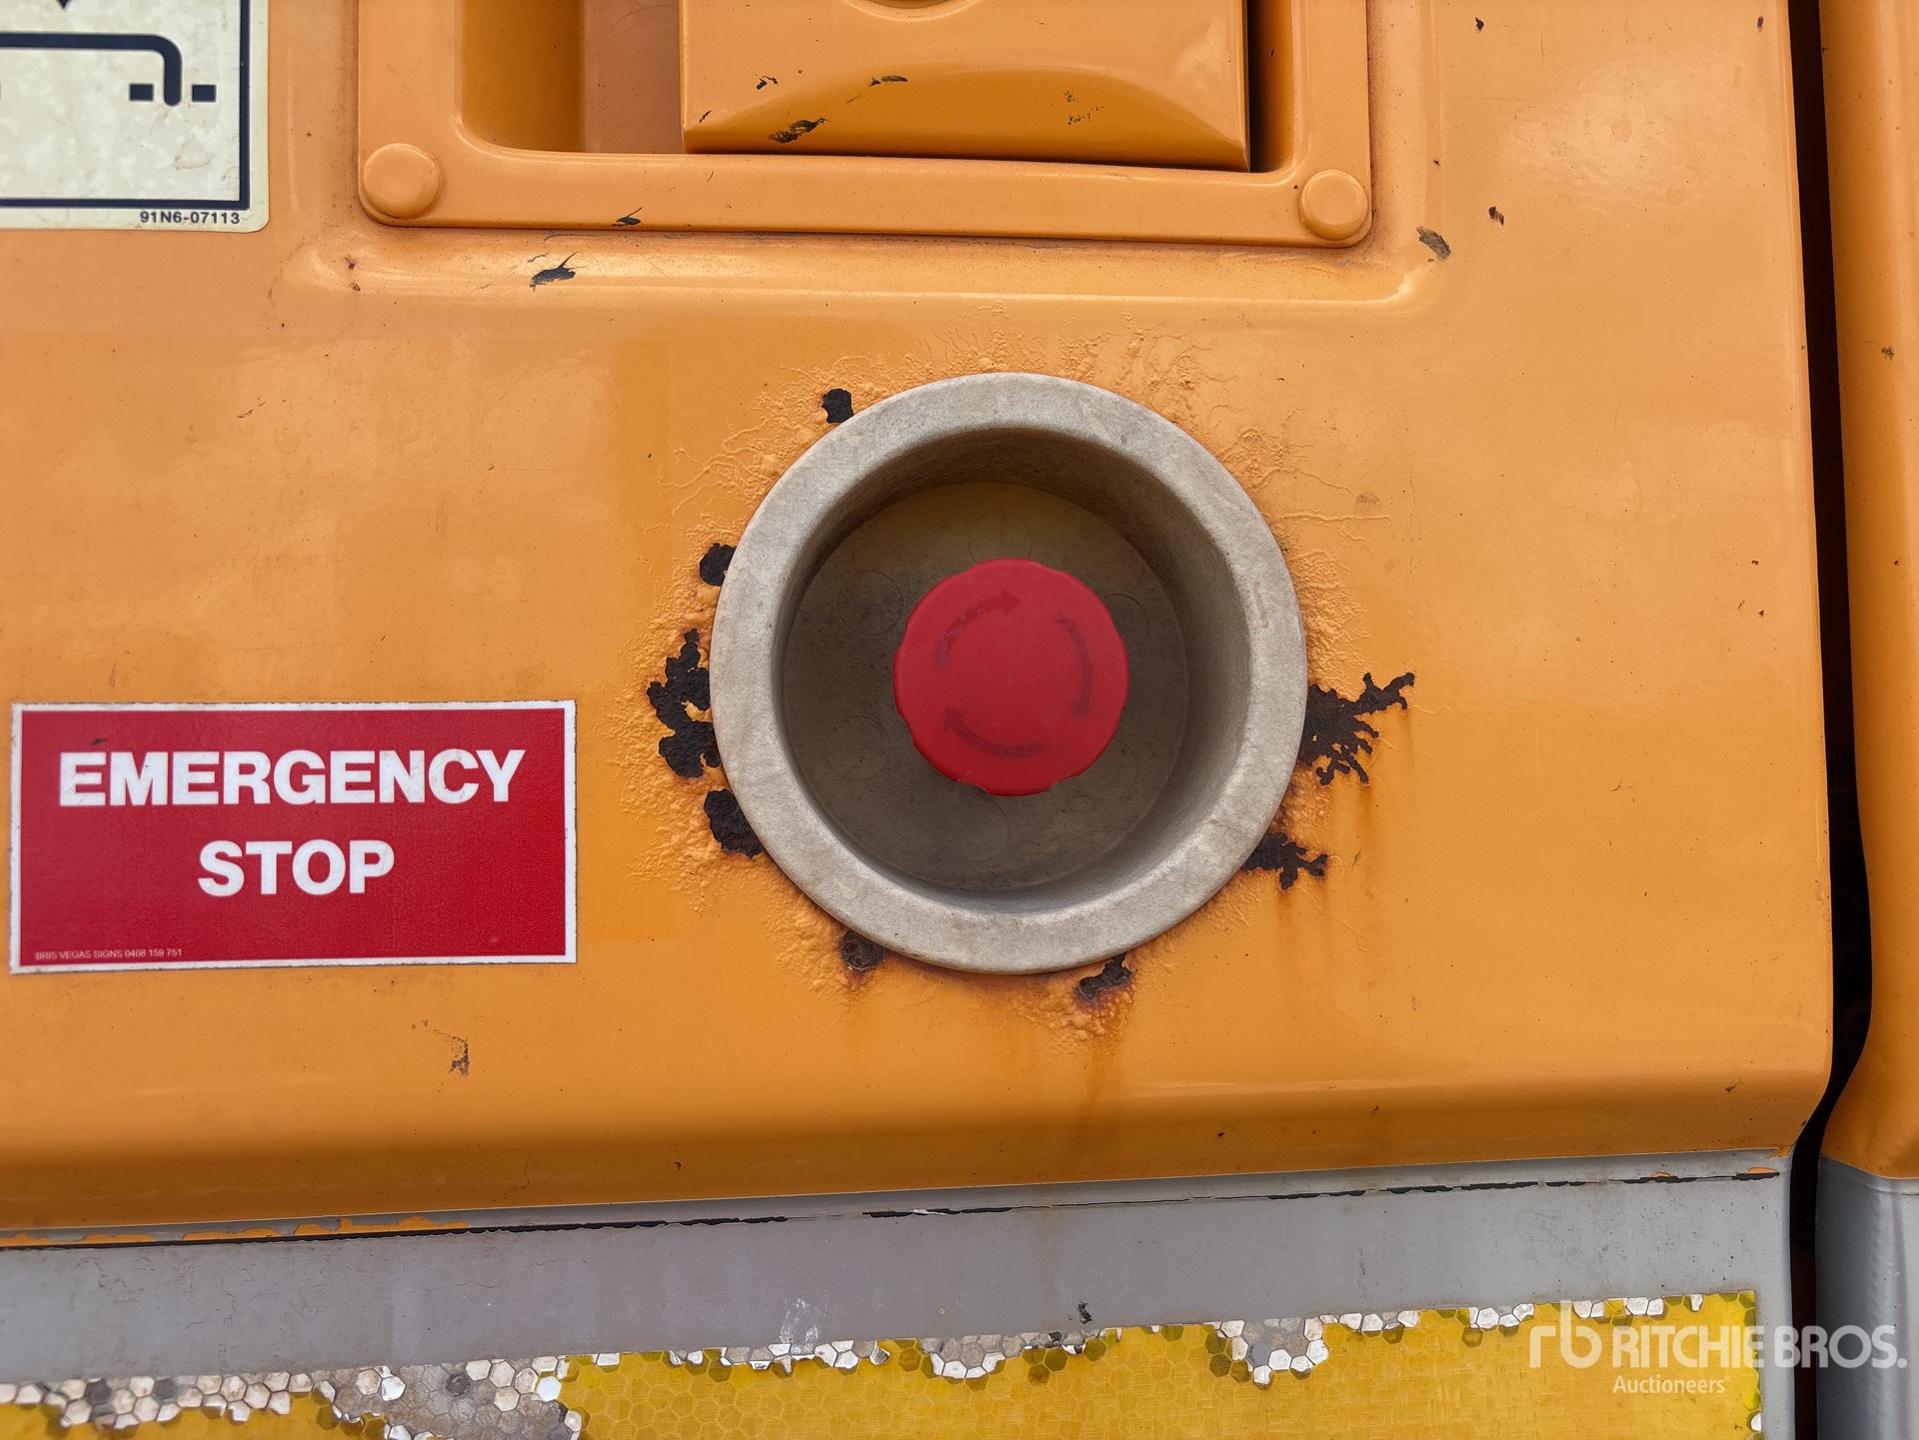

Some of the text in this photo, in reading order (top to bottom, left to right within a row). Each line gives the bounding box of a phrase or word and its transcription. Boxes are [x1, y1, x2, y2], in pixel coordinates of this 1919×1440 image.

[139, 211, 240, 225] 91N6-07113
[59, 748, 526, 807] EMERGENCY
[197, 839, 395, 897] STOP
[35, 948, 182, 960] BRIS VEGAS SIGNS 0408 159 751
